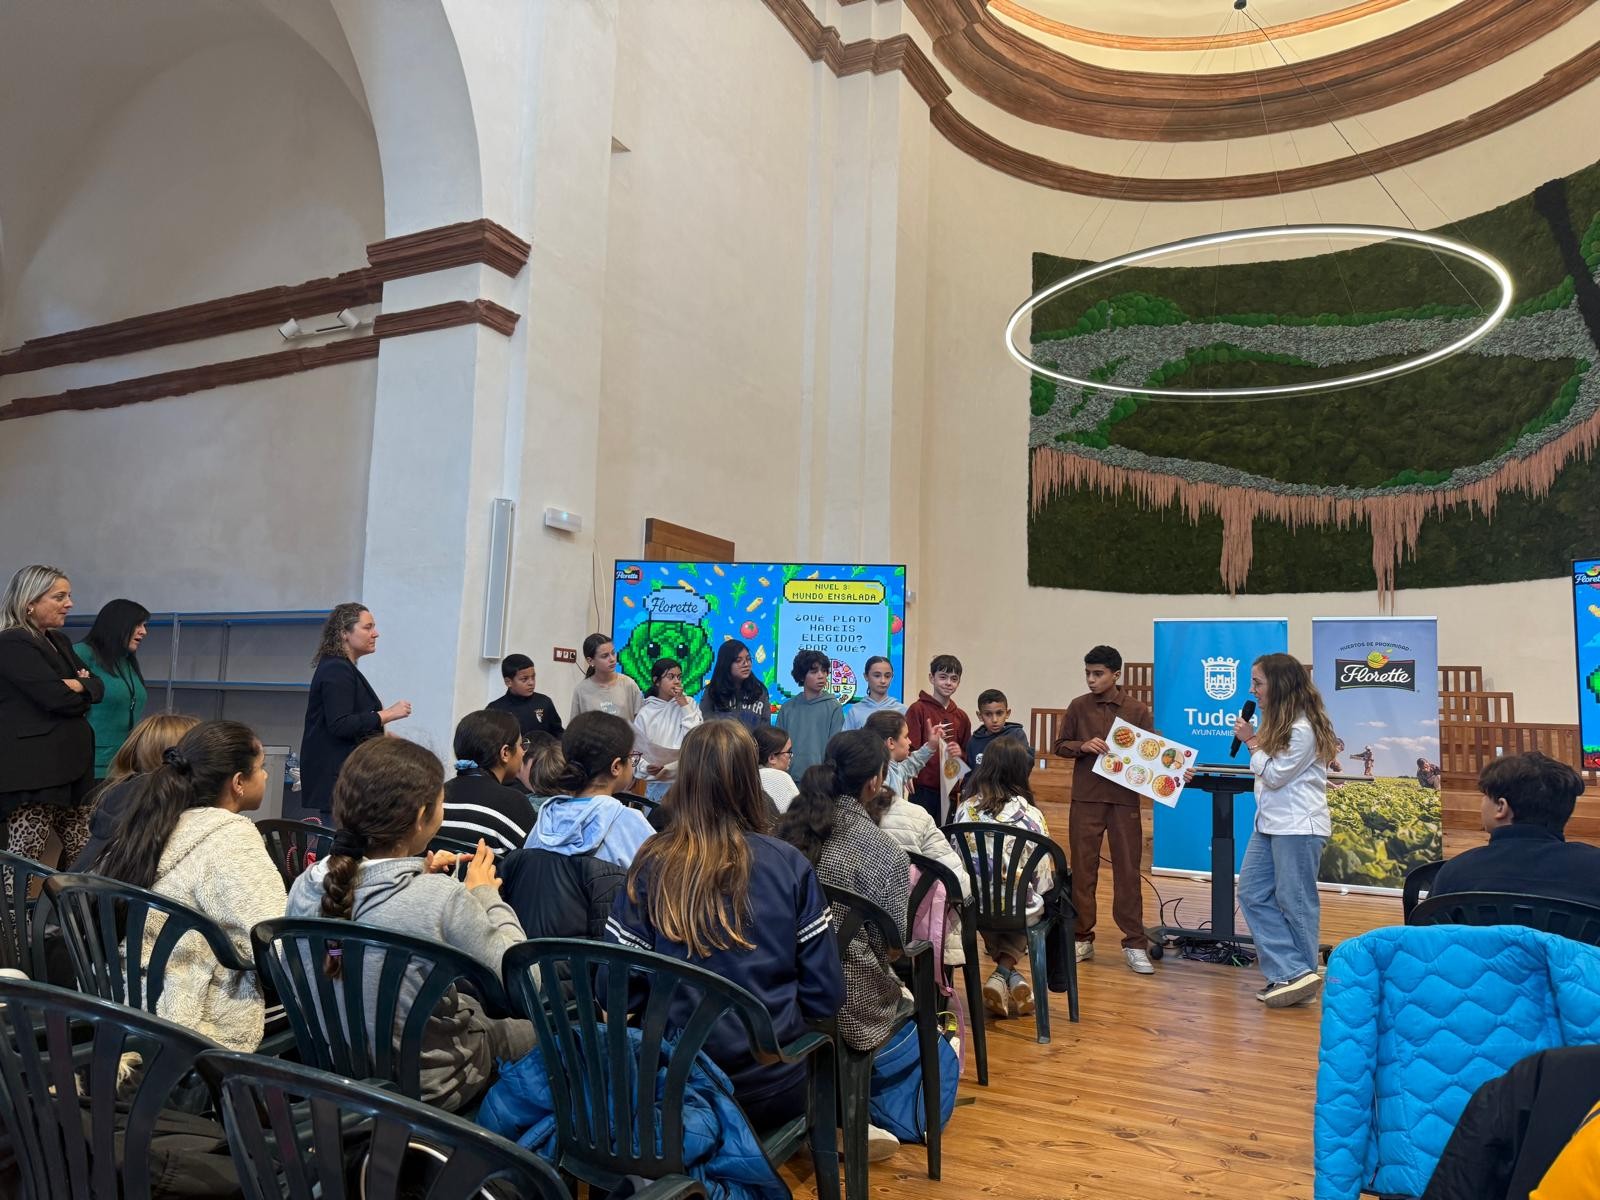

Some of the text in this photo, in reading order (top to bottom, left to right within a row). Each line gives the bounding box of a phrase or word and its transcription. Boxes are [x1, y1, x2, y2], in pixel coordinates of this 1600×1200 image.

[792, 592, 876, 601] MUNDO ENSALADA
[650, 596, 699, 613] Florette
[795, 614, 872, 623] ¿QUÉ PLATO
[809, 624, 856, 632] HABÉIS
[802, 633, 863, 643] ELEGIDO?
[798, 643, 867, 653] ¿POR QUÉ?
[1339, 641, 1365, 652] HUERTOS
[1374, 641, 1410, 652] PROXIMIDAD
[1340, 664, 1412, 683] Florette
[1191, 728, 1235, 737] AYUNTAMIE
